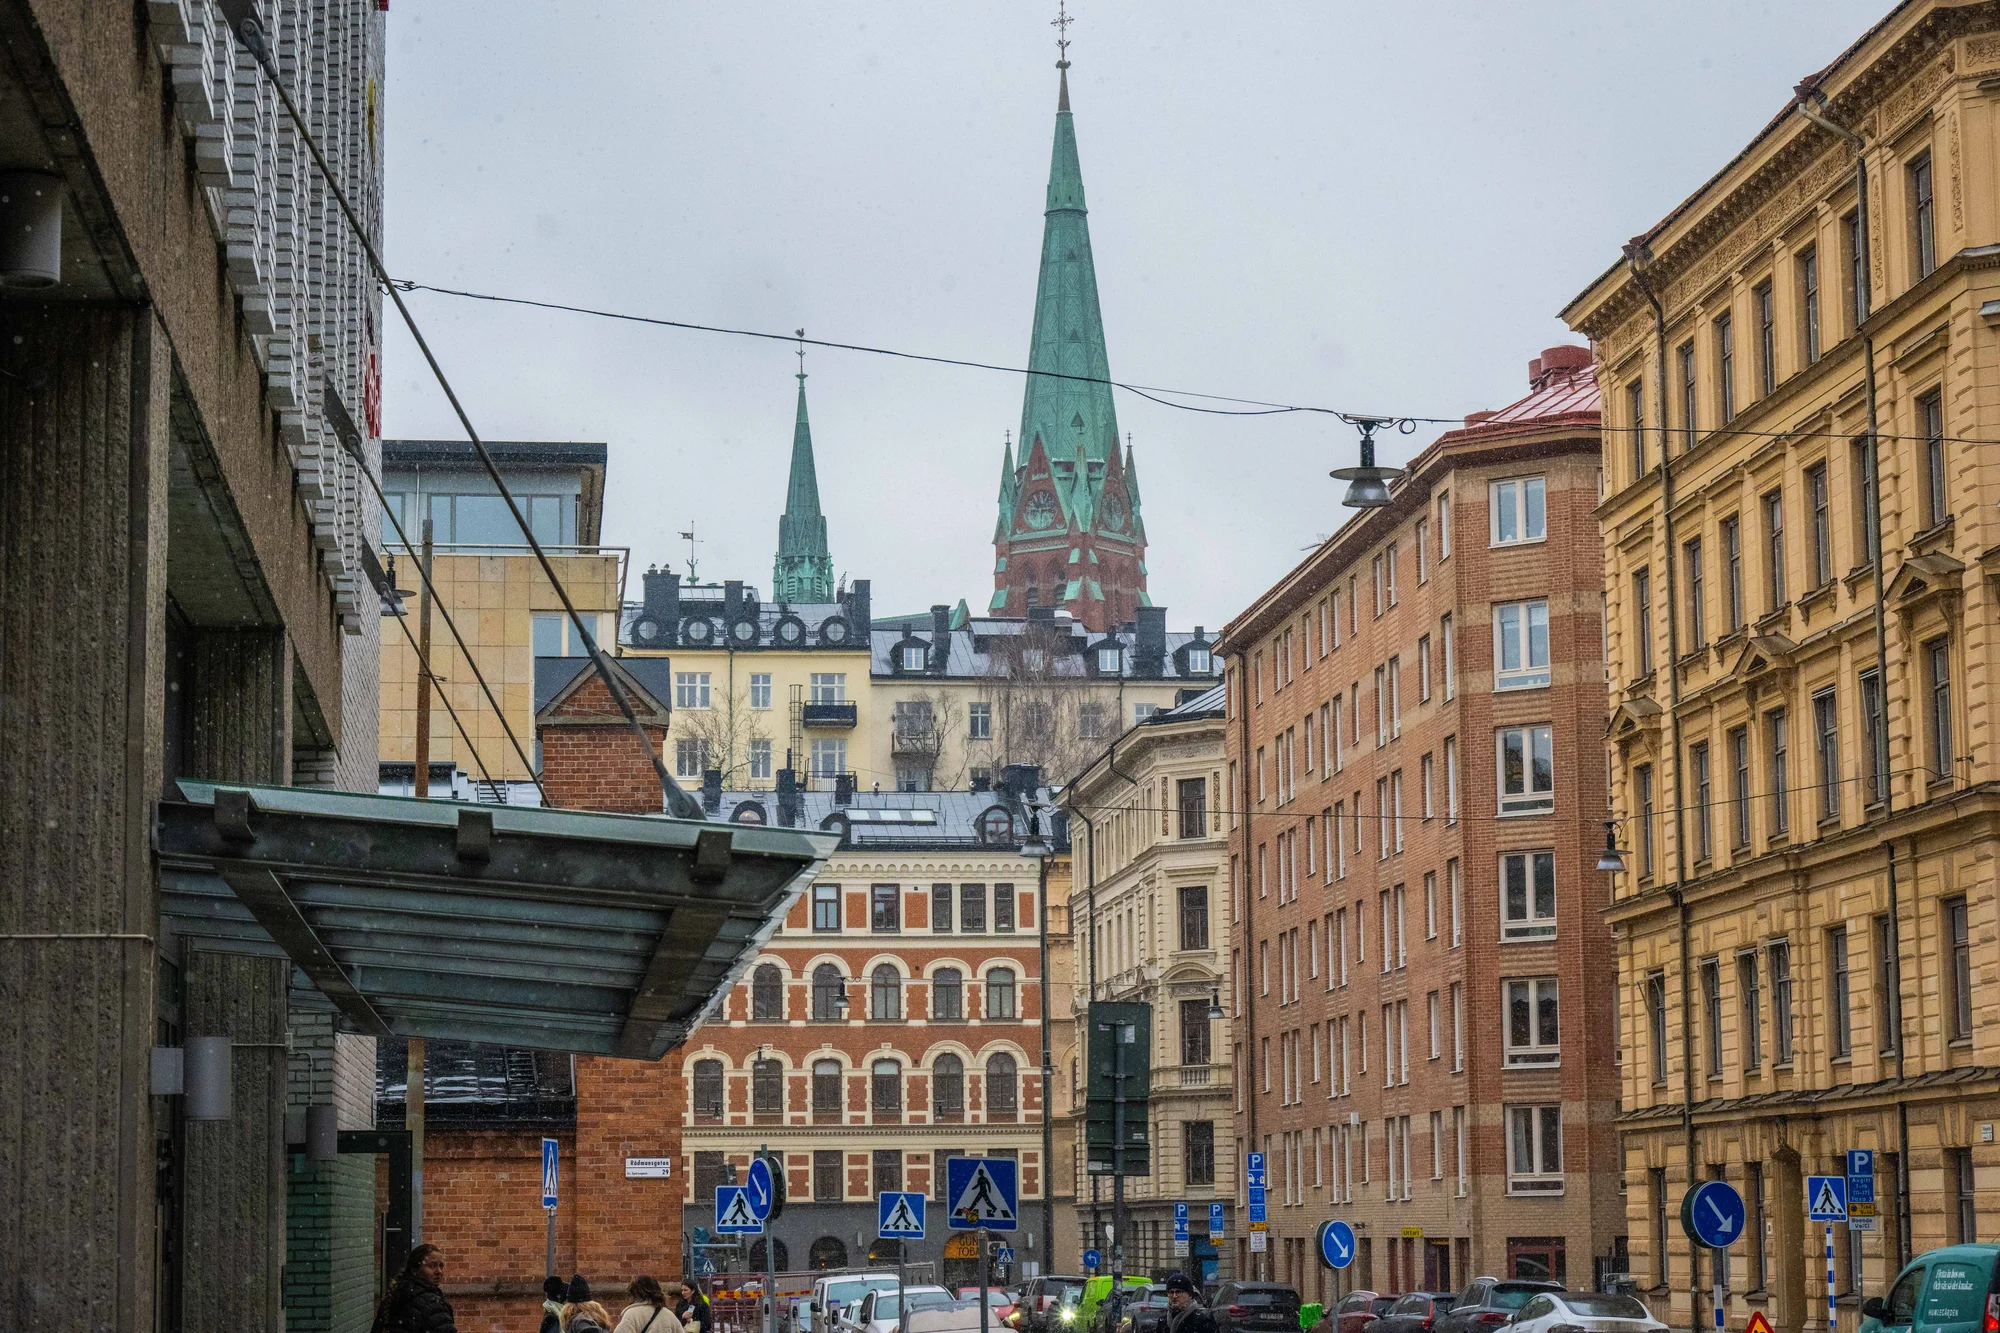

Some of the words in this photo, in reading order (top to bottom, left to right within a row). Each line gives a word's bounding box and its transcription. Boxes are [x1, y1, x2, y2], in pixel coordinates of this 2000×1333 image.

[1252, 1154, 1260, 1168] P
[1854, 1152, 1868, 1173] P
[1178, 1204, 1186, 1216] P
[1212, 1204, 1221, 1216] P
[959, 1236, 979, 1247] GUN
[958, 1246, 980, 1256] TOBA
